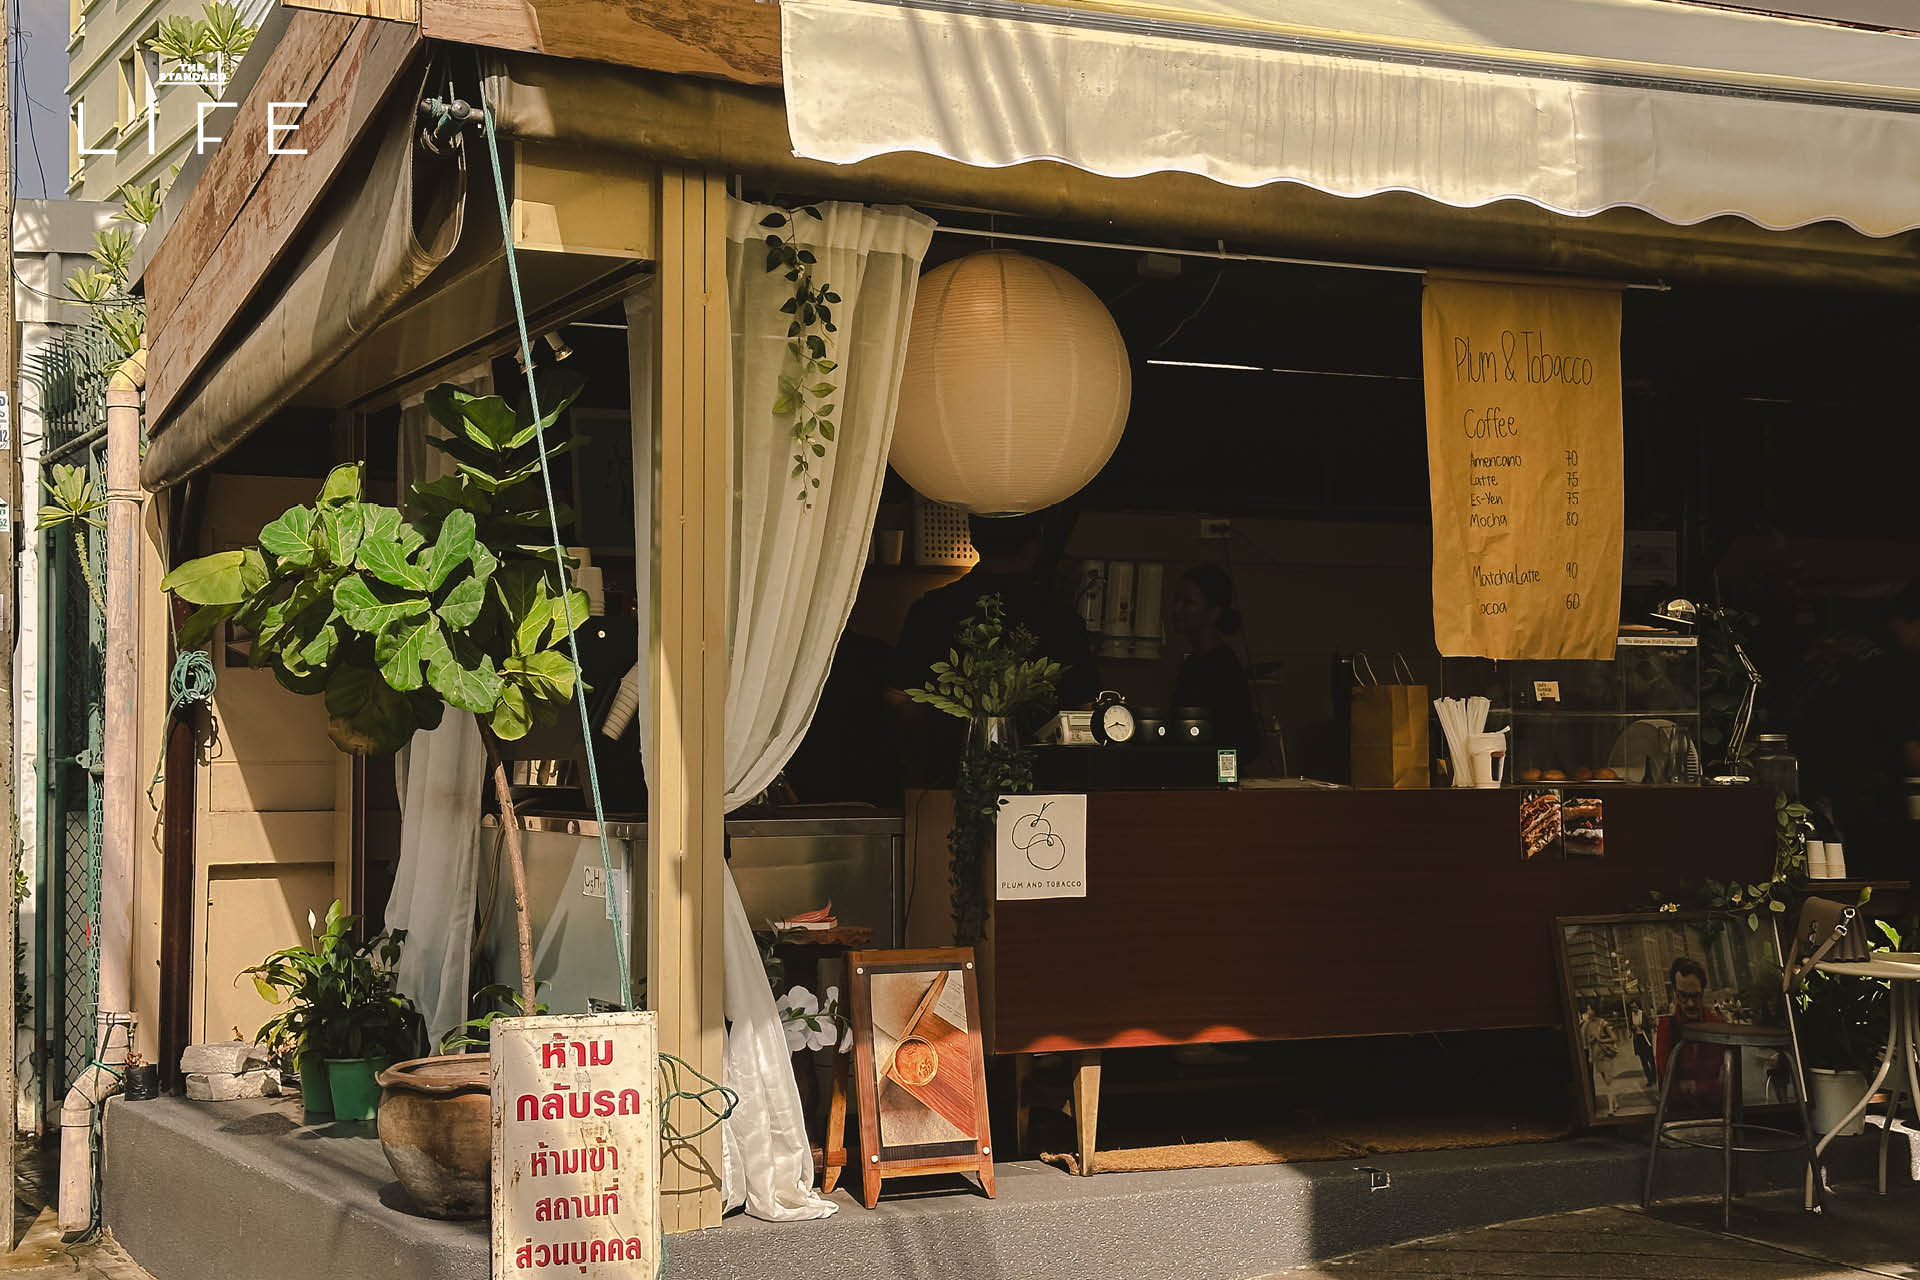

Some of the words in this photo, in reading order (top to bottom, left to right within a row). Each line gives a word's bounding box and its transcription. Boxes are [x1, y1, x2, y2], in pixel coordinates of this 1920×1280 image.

[1454, 336, 1498, 383] Plum
[1501, 330, 1518, 383] &
[1520, 328, 1593, 386] Tobacco
[1463, 407, 1518, 439] Coffee
[1470, 451, 1522, 468] Americano
[1565, 450, 1579, 466] 70
[1470, 473, 1498, 486] Latte
[1565, 471, 1579, 487] 75
[1566, 491, 1580, 505] 75
[1470, 512, 1508, 528] Mocha
[1565, 512, 1579, 526] 80
[1565, 562, 1578, 580] 90
[1565, 592, 1580, 610] 60
[1001, 881, 1024, 889] PLUM
[1046, 880, 1082, 888] TOBACCO
[541, 1032, 614, 1069] ห้าม
[516, 1083, 640, 1122] กลับรถ
[531, 1137, 619, 1177] ห้ามเข้า
[535, 1178, 620, 1222] สถานที่
[515, 1237, 642, 1274] ส่วนบุคคล
